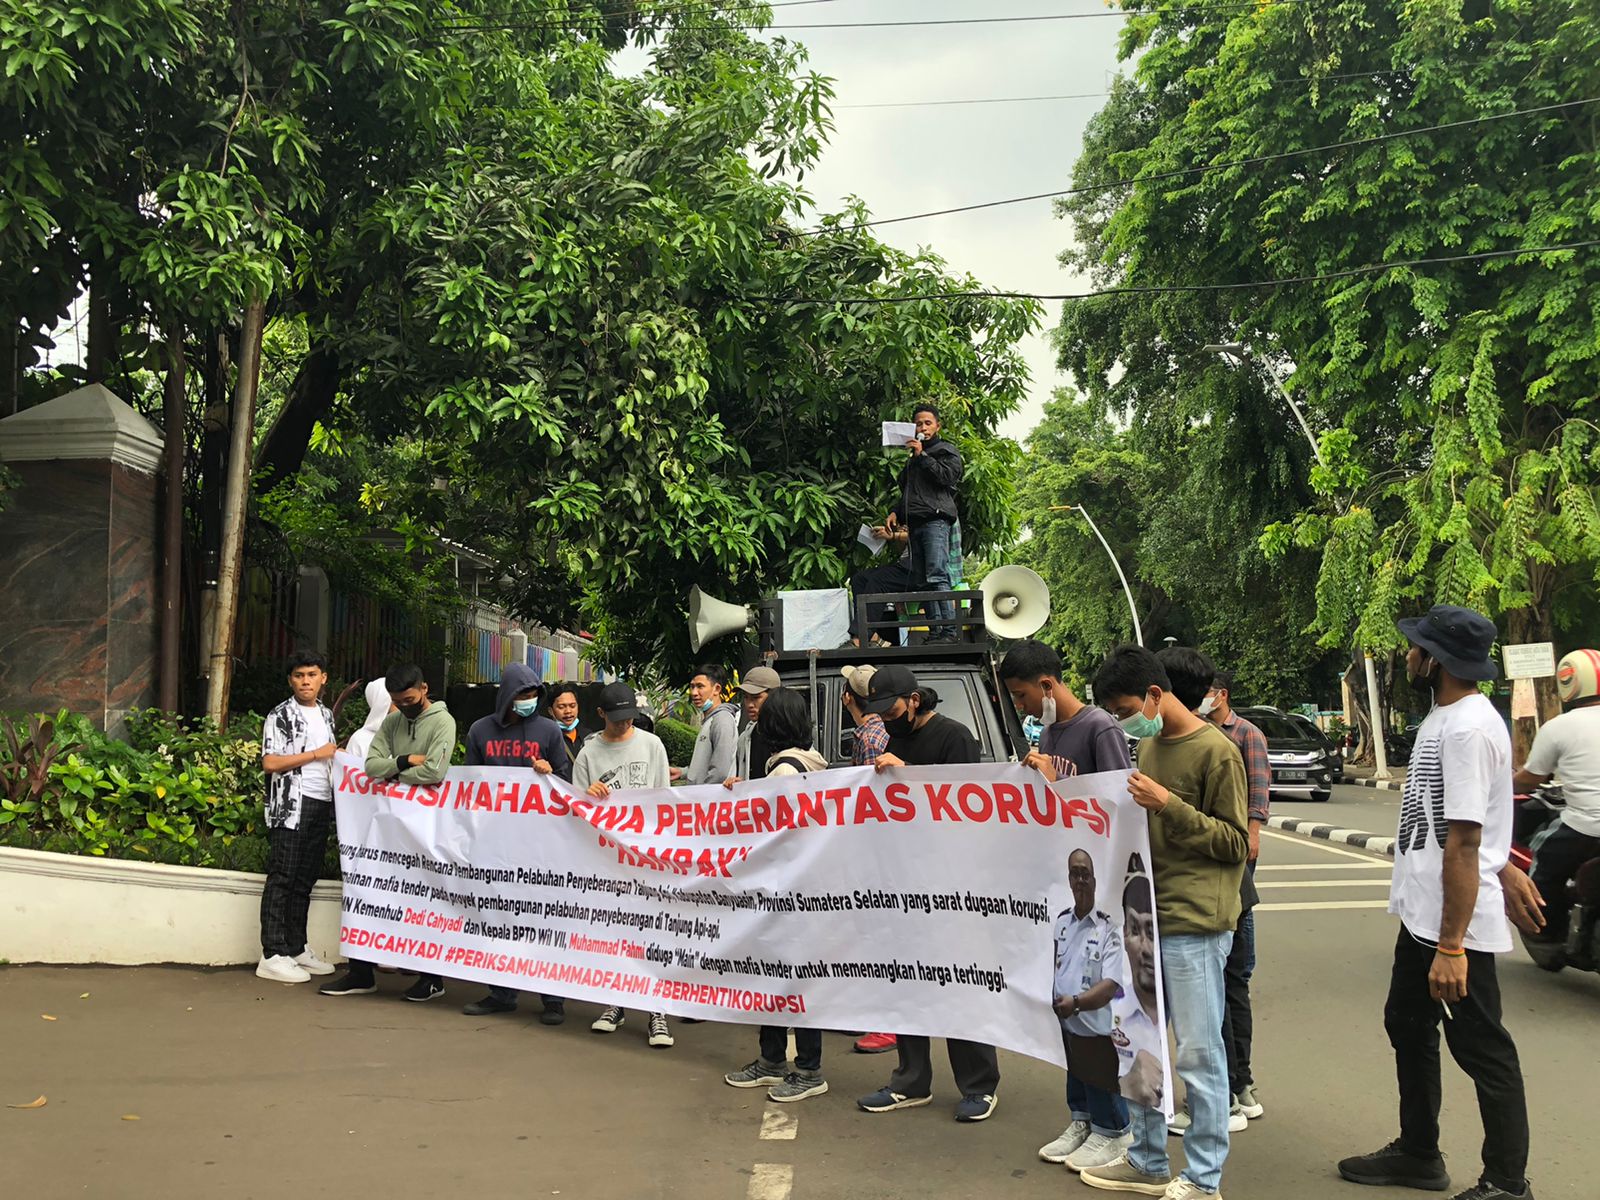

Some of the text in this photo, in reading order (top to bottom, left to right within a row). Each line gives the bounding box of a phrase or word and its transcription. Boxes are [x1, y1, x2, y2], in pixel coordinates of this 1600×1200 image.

[654, 783, 916, 837] PEMBERANTAS
[373, 875, 399, 893] mafia
[400, 879, 429, 898] tender
[430, 886, 449, 902] pada
[449, 891, 476, 908] proyek
[478, 894, 543, 916] pembangunan
[544, 900, 589, 921] pelabuhan
[590, 907, 653, 931] penyeberangan
[655, 911, 663, 930] di
[664, 913, 692, 938] Tanjung
[693, 917, 720, 942] Api-api.
[380, 849, 420, 869] mencegah
[421, 854, 453, 876] Rencana
[517, 867, 564, 887] Pelabuhan
[566, 871, 632, 897] Penyeberangan
[712, 890, 757, 913] Banyuasin,
[757, 891, 796, 912] Provinsi
[796, 892, 853, 912] Sumatera
[853, 889, 900, 910] Selatan
[900, 893, 931, 914] yang
[932, 891, 963, 911] sarat
[964, 890, 1008, 917] dugaan
[1008, 894, 1050, 925] korupsi.
[353, 898, 403, 921] Kemenhub
[403, 907, 427, 925] Dedi
[427, 911, 463, 933] Cahyadi
[463, 918, 480, 936] dan
[480, 921, 510, 941] Kepala
[513, 925, 536, 943] BPTD
[538, 928, 553, 946] Wil
[554, 930, 567, 951] VII,
[569, 933, 619, 956] Muhammad
[620, 939, 645, 960] Fahmi
[646, 942, 673, 967] diduga
[700, 952, 733, 975] dengan
[734, 955, 761, 975] mafia
[760, 959, 793, 979] tender
[794, 959, 830, 979] untuk
[831, 959, 917, 983] memenangkan
[916, 960, 952, 986] harga
[953, 963, 1008, 992] tertinggi.
[445, 946, 651, 995] #PERIKSAMUHAMMADFAHMI
[652, 978, 806, 1014] #BERHENTIKORUPSI
